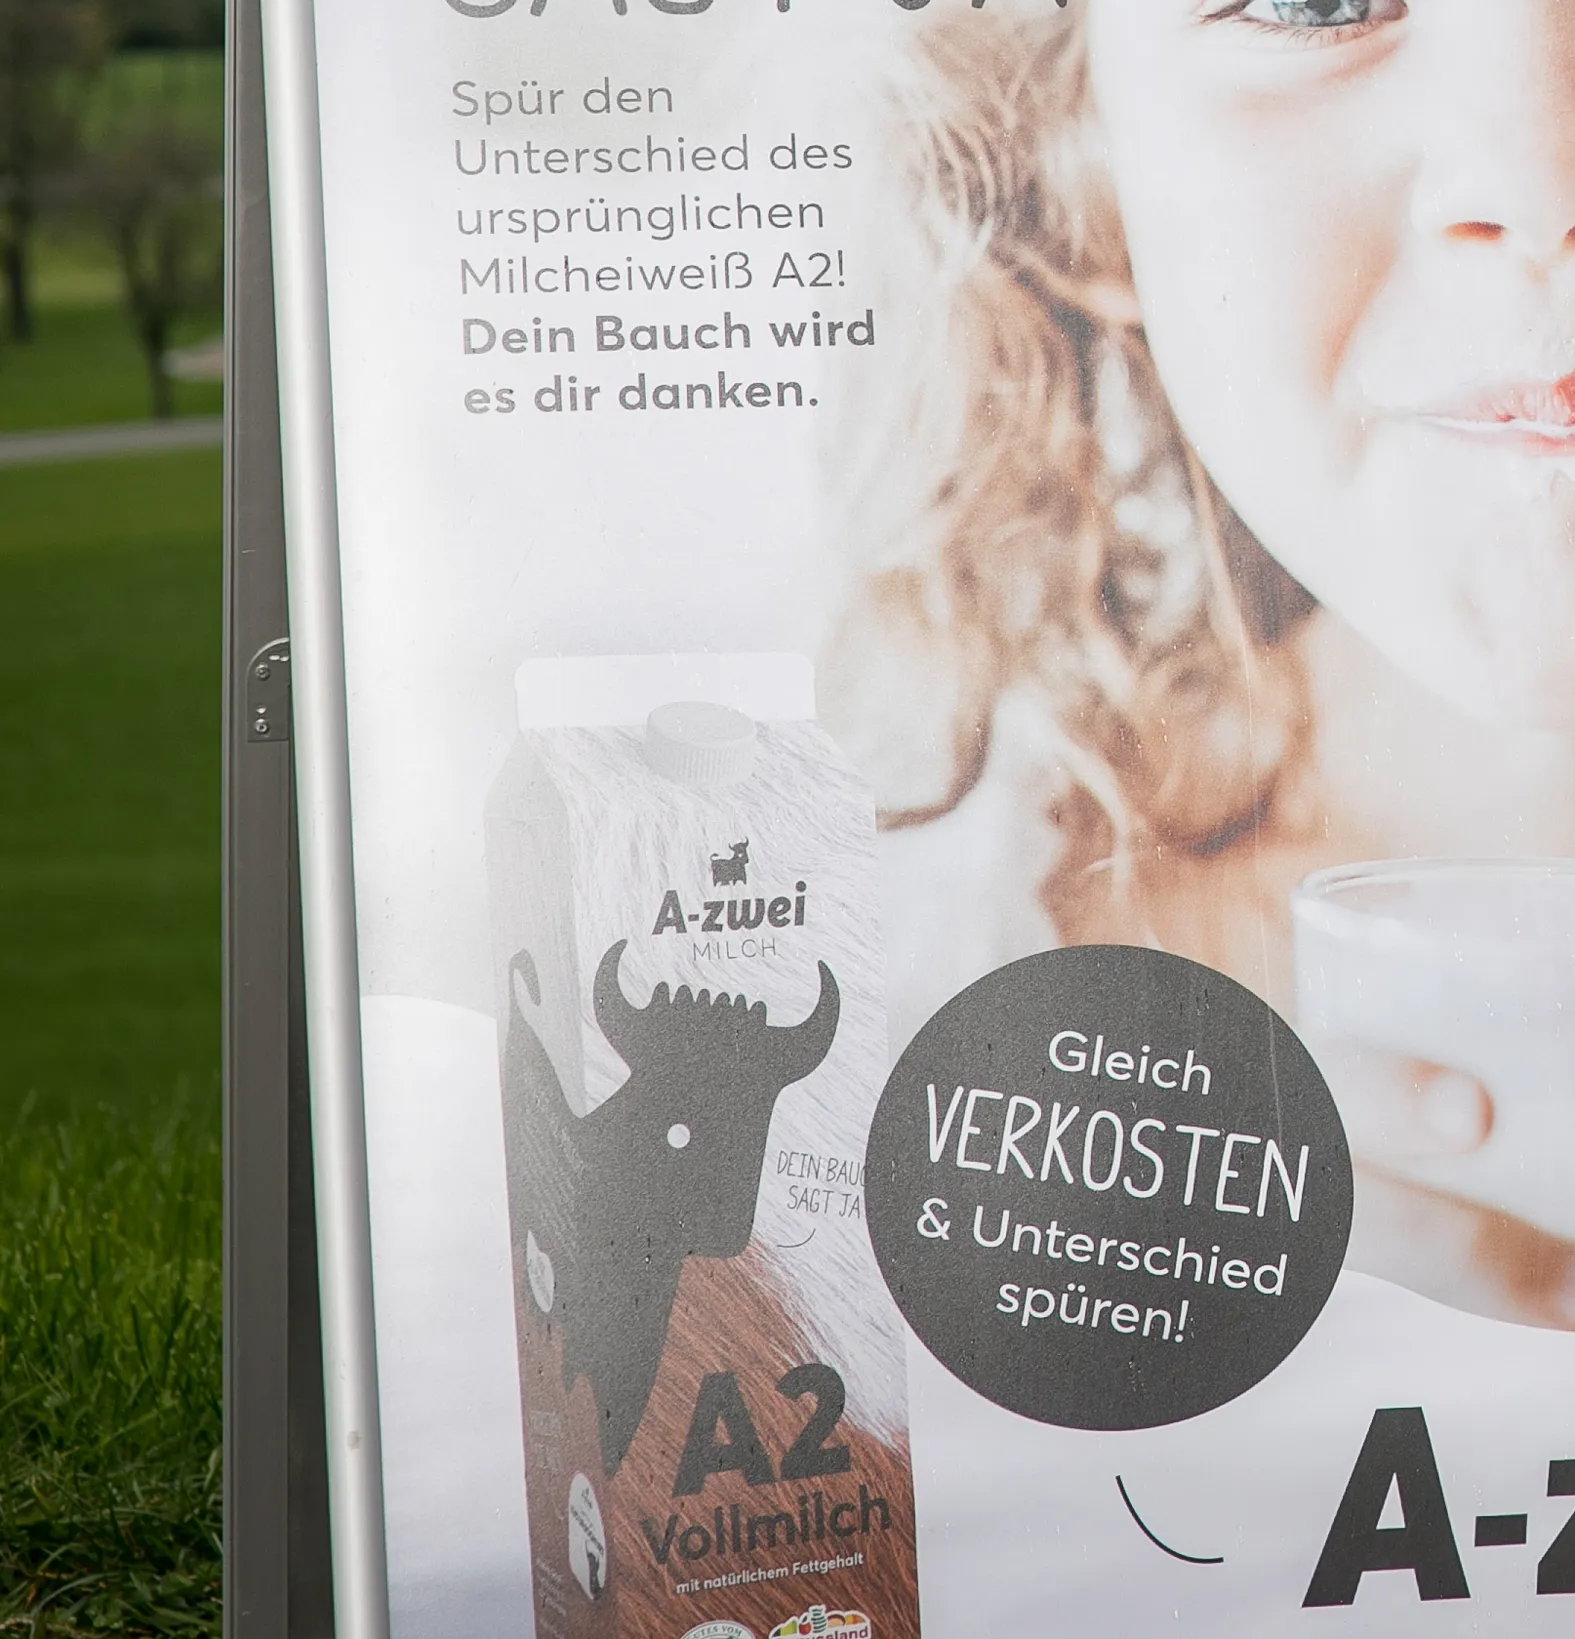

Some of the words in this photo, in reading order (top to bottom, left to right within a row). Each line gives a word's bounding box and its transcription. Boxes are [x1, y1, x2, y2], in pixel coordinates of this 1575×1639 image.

[451, 80, 564, 124] Spür
[582, 79, 674, 116] den
[453, 136, 749, 176] Unterschied
[768, 133, 853, 173] des
[456, 194, 825, 242] ursprünglichen
[460, 251, 752, 296] Milcheiweiß
[772, 250, 846, 290] A2!
[462, 315, 576, 357] Dein
[595, 312, 750, 354] Bauch
[769, 308, 876, 349] wird
[464, 380, 517, 415] es
[534, 375, 600, 414] dir
[618, 371, 818, 412] danken.
[652, 881, 807, 936] A-zwei
[692, 938, 778, 961] MILCH
[1047, 1030, 1214, 1096] Gleich
[777, 1150, 821, 1180] DEIN
[826, 1158, 865, 1186] BAU
[926, 1083, 1312, 1223] VERKOSTEN
[787, 1185, 834, 1214] SAGT
[839, 1193, 860, 1219] JA
[917, 1197, 952, 1239] &
[973, 1209, 1289, 1297] Unterschied
[996, 1277, 1191, 1343] spüren!
[672, 1363, 850, 1497] A2
[640, 1485, 891, 1564] Vollmilch
[676, 1579, 700, 1594] mit
[704, 1566, 788, 1591] natürlichem
[793, 1552, 864, 1577] Fettgehalt
